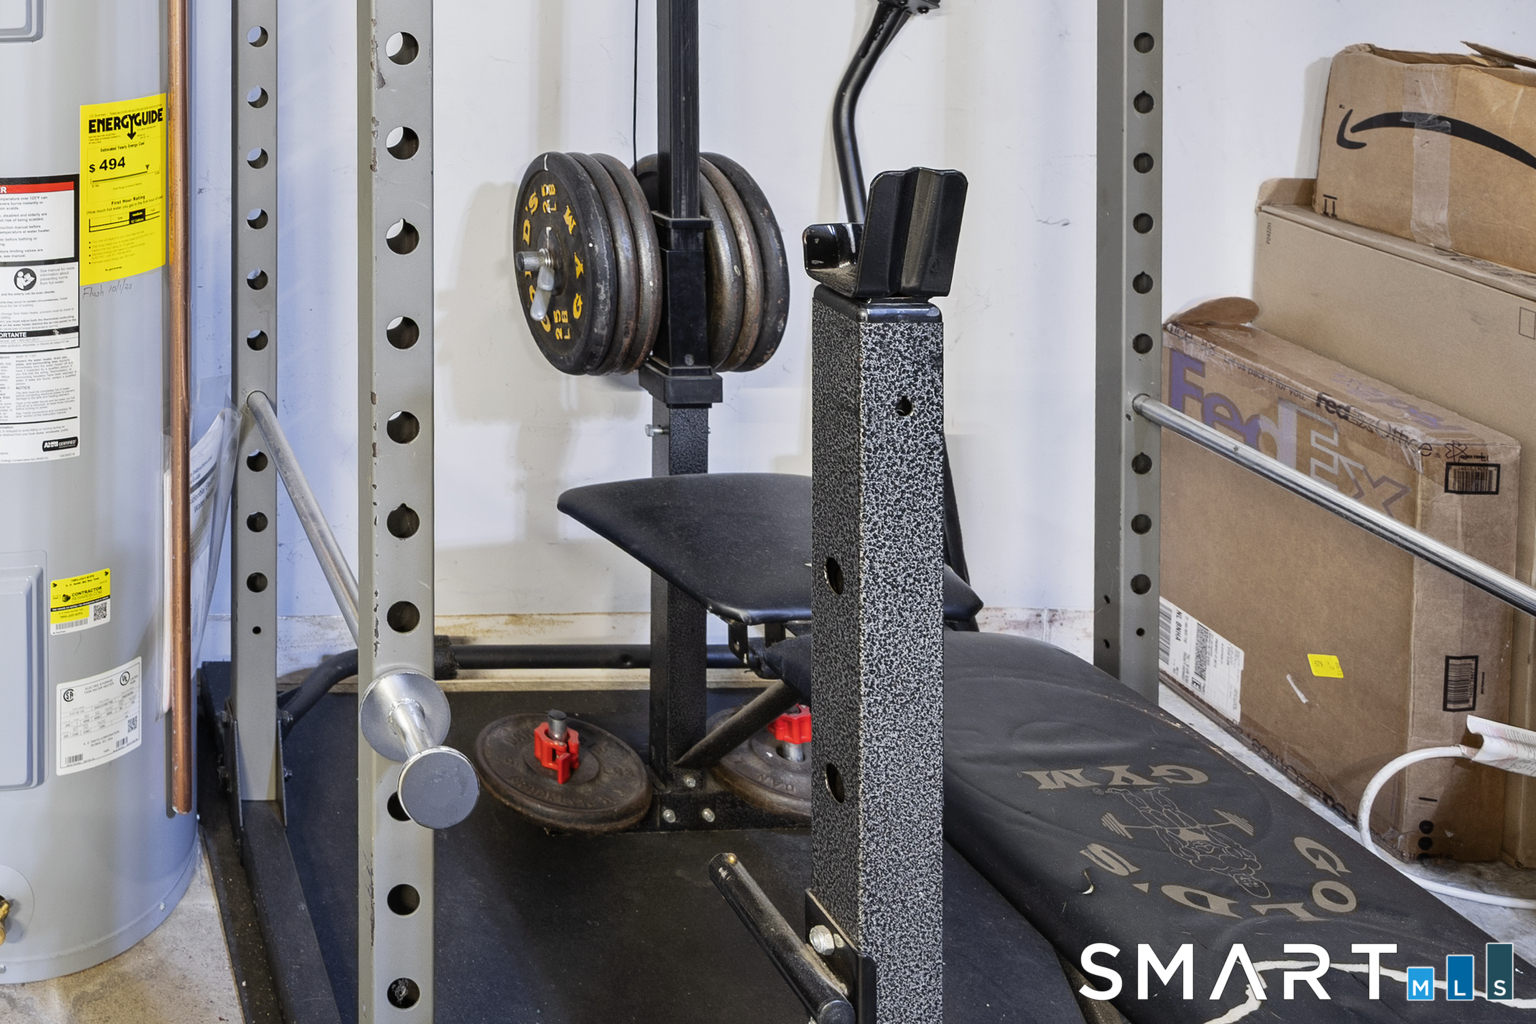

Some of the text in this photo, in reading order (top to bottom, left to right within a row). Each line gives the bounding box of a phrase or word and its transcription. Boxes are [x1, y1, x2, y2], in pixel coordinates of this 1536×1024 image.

[88, 107, 163, 134] ENERGYGUIDE
[88, 156, 126, 173] $ 494
[554, 309, 562, 340] 25
[562, 310, 570, 339] LB
[1275, 380, 1286, 391] for
[71, 586, 102, 597] CONTRACTOR
[1022, 765, 1209, 790] GYM
[1079, 837, 1358, 921] GOLD'S
